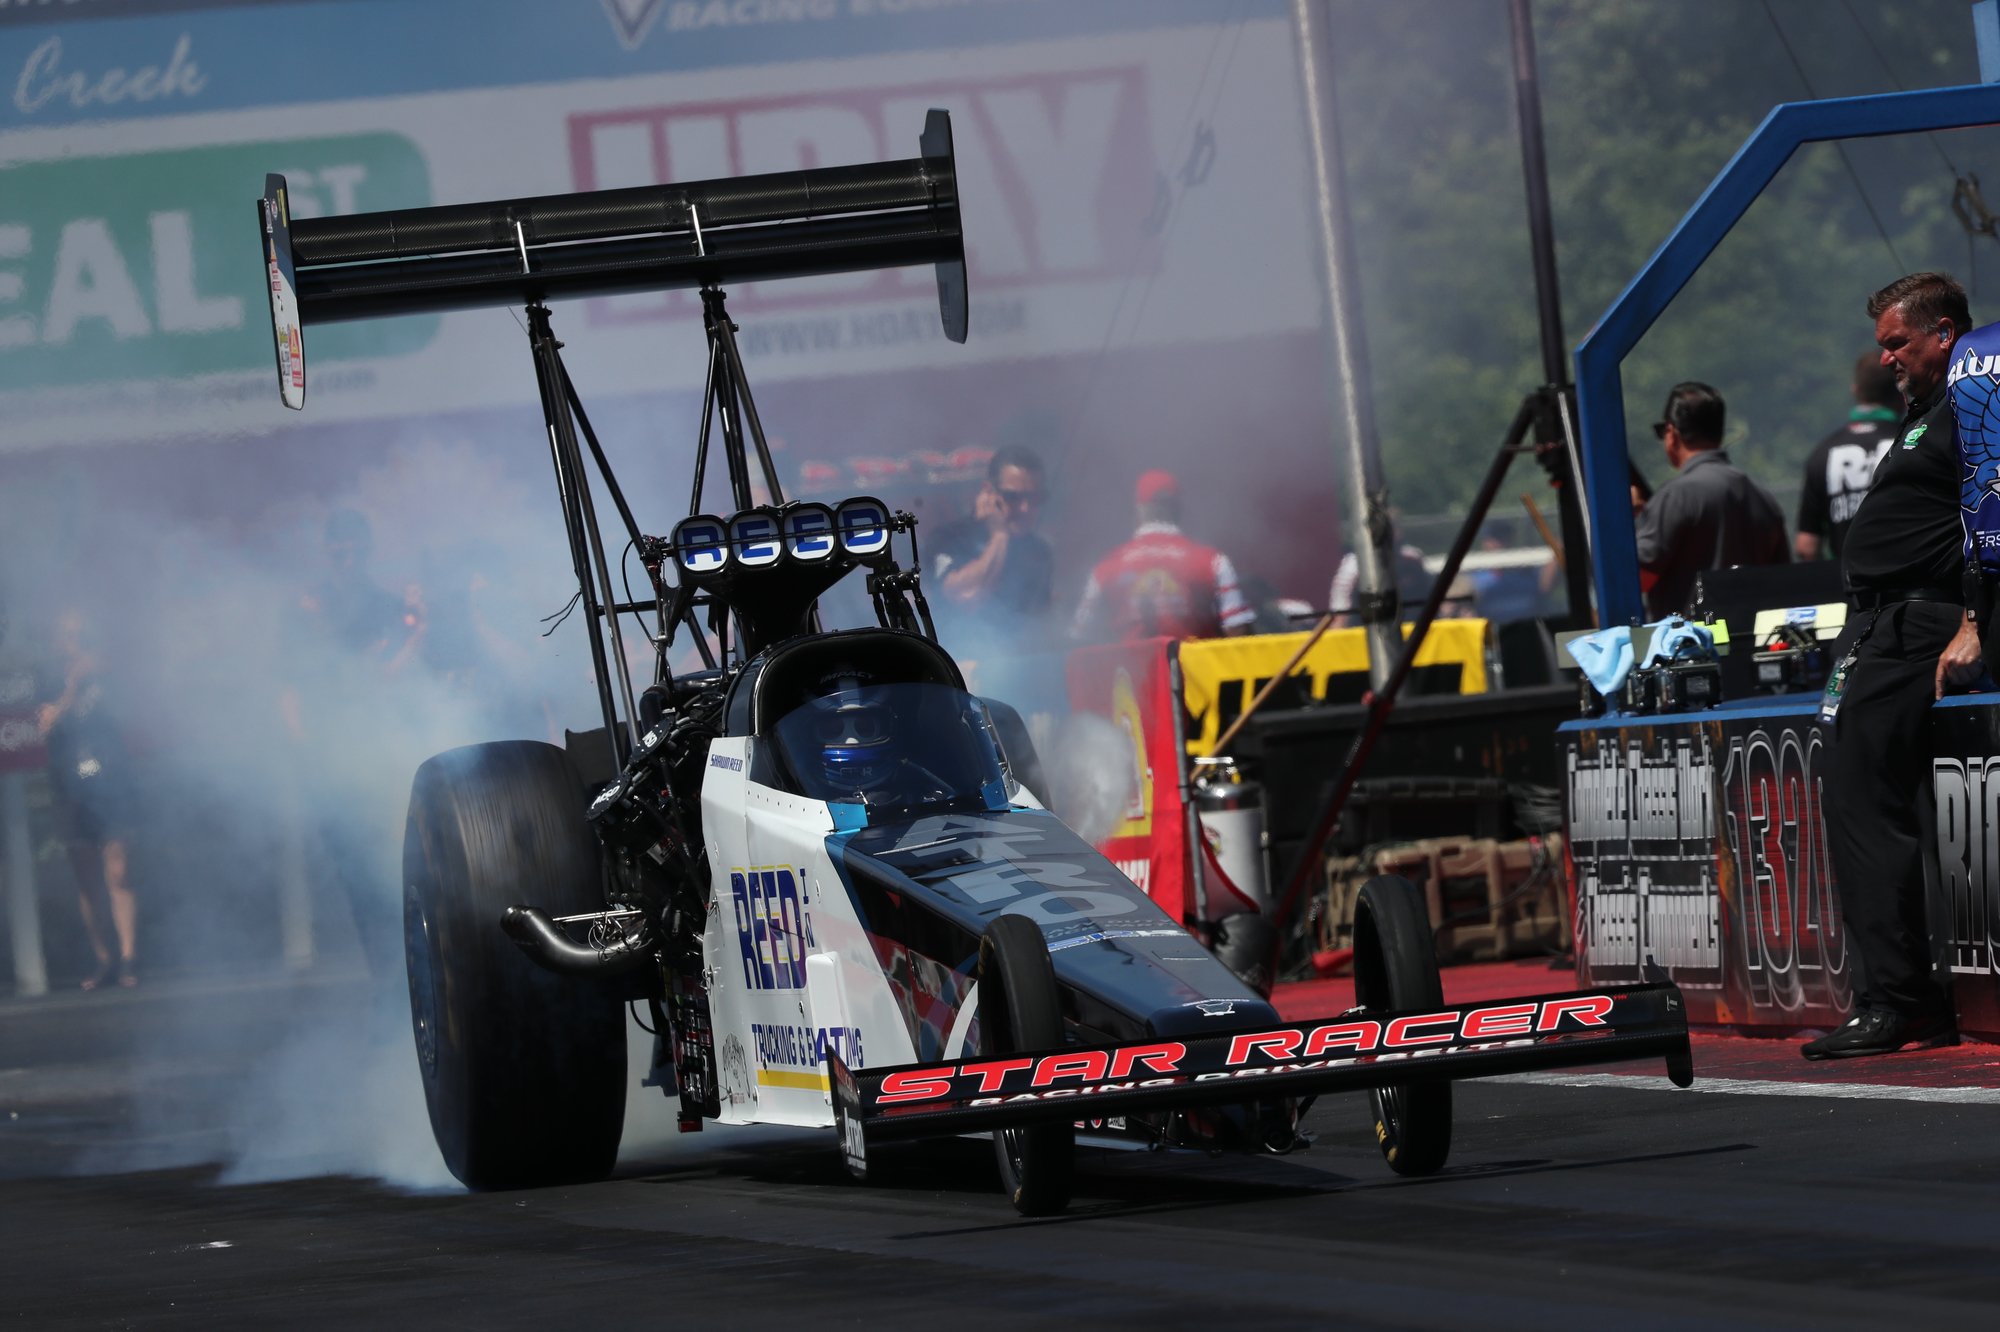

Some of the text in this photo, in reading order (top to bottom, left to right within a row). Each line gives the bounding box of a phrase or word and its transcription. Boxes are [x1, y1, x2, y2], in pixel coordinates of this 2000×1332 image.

[15, 33, 210, 113] Creek
[682, 508, 884, 564] REED
[710, 754, 743, 772] SHAWN REED
[731, 864, 807, 990] REED
[751, 1023, 797, 1066] TRUCKING
[797, 1026, 807, 1067] &
[876, 1042, 1187, 1104] STAR
[1225, 995, 1614, 1066] RACER
[969, 1077, 1176, 1107] RACING
